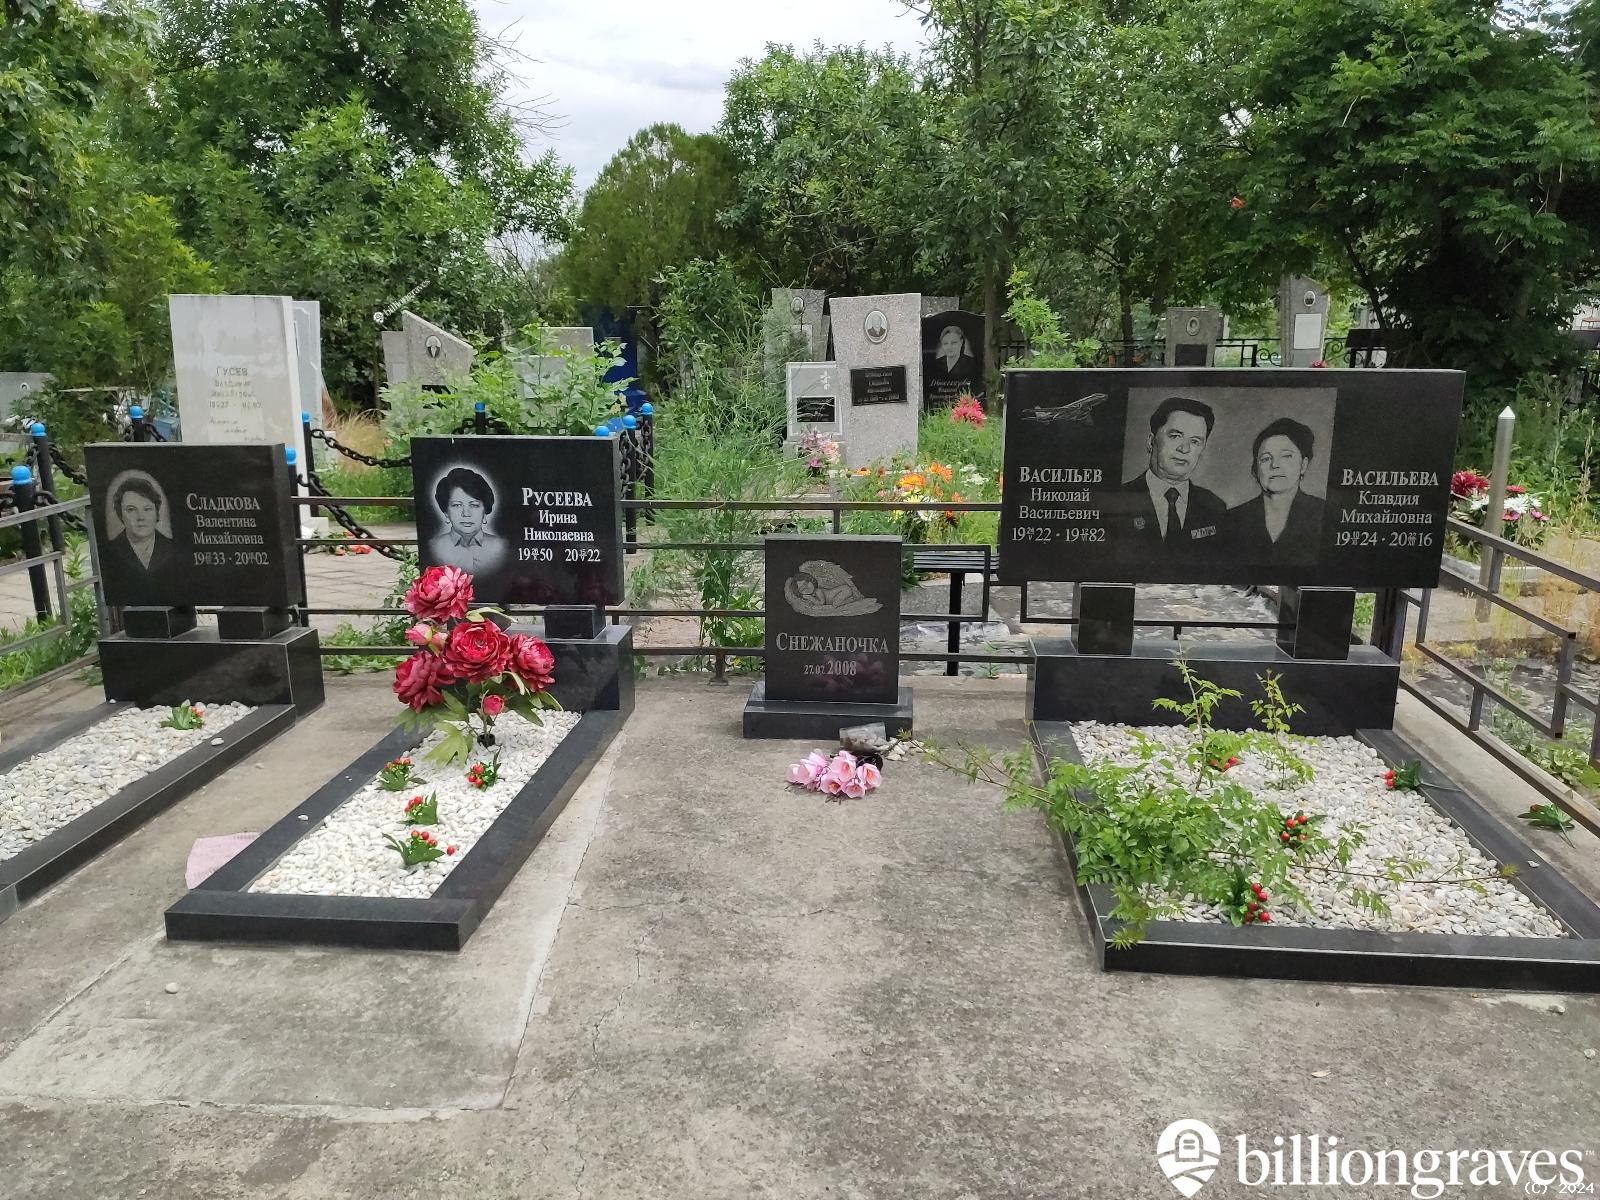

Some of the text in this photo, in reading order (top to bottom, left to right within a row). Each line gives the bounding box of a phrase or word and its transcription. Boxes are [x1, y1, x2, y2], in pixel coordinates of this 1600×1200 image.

[1019, 466, 1103, 483] ВАСИЛЬЕВ
[1340, 468, 1439, 486] ВАСИЛЬЕВА
[186, 493, 261, 512] СЛАДКОВА
[521, 487, 594, 506] РУСЕЕВА
[1031, 487, 1091, 502] Николай
[1358, 490, 1420, 507] Клавдия
[195, 514, 257, 528] Валентина
[539, 509, 578, 527] Ирина
[1019, 505, 1100, 520] Васильевич
[1340, 508, 1433, 524] Михайловна
[193, 531, 264, 545] Михайловна
[524, 527, 595, 542] Николаевна
[775, 632, 889, 654] СНЕЖАНОЧКА
